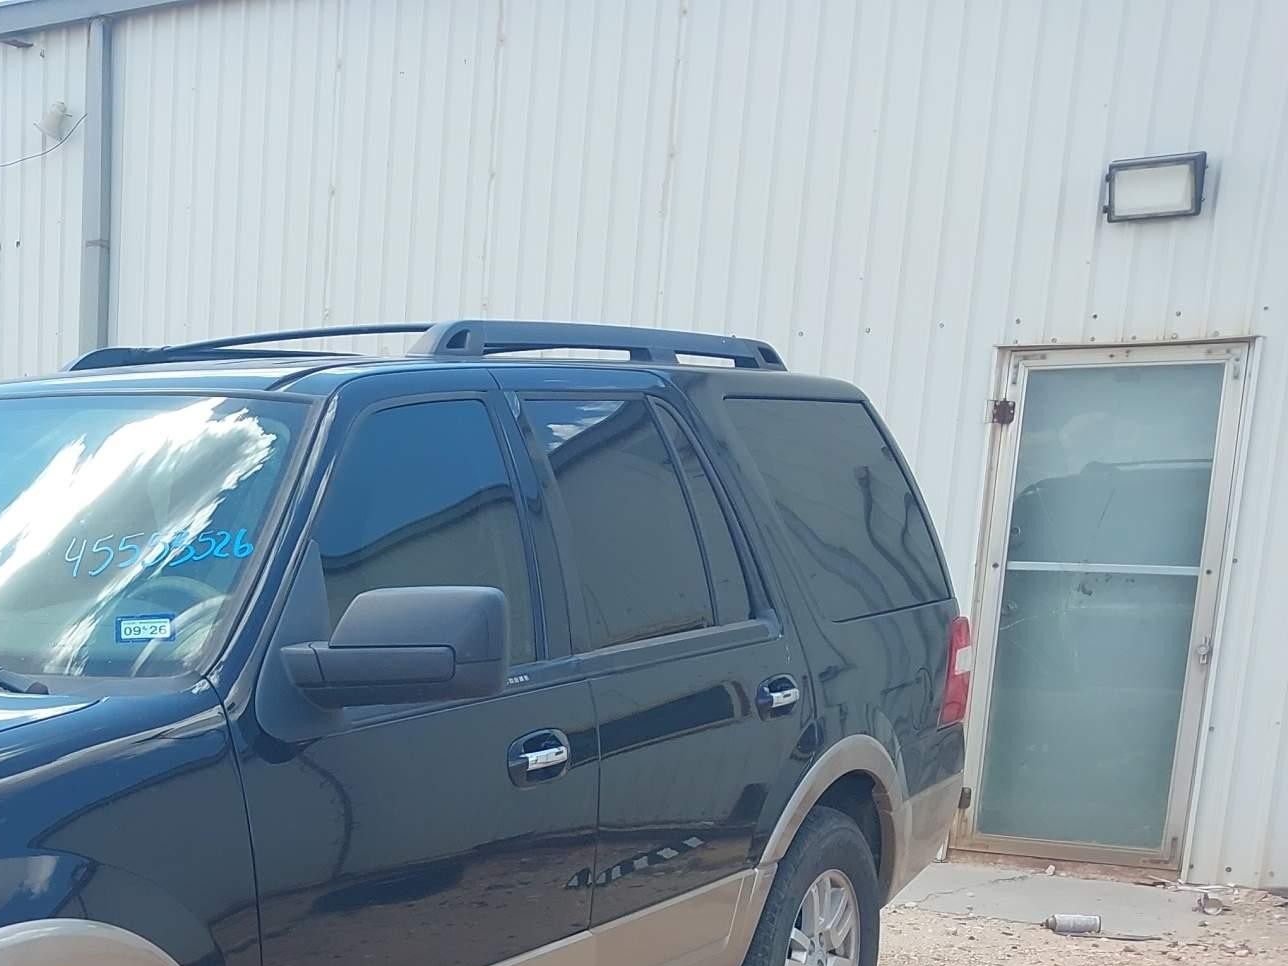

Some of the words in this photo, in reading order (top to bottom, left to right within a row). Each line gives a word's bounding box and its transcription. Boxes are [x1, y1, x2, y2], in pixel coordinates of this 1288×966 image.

[64, 527, 254, 577] 45553526
[123, 626, 141, 636] 09
[149, 625, 167, 635] 26
